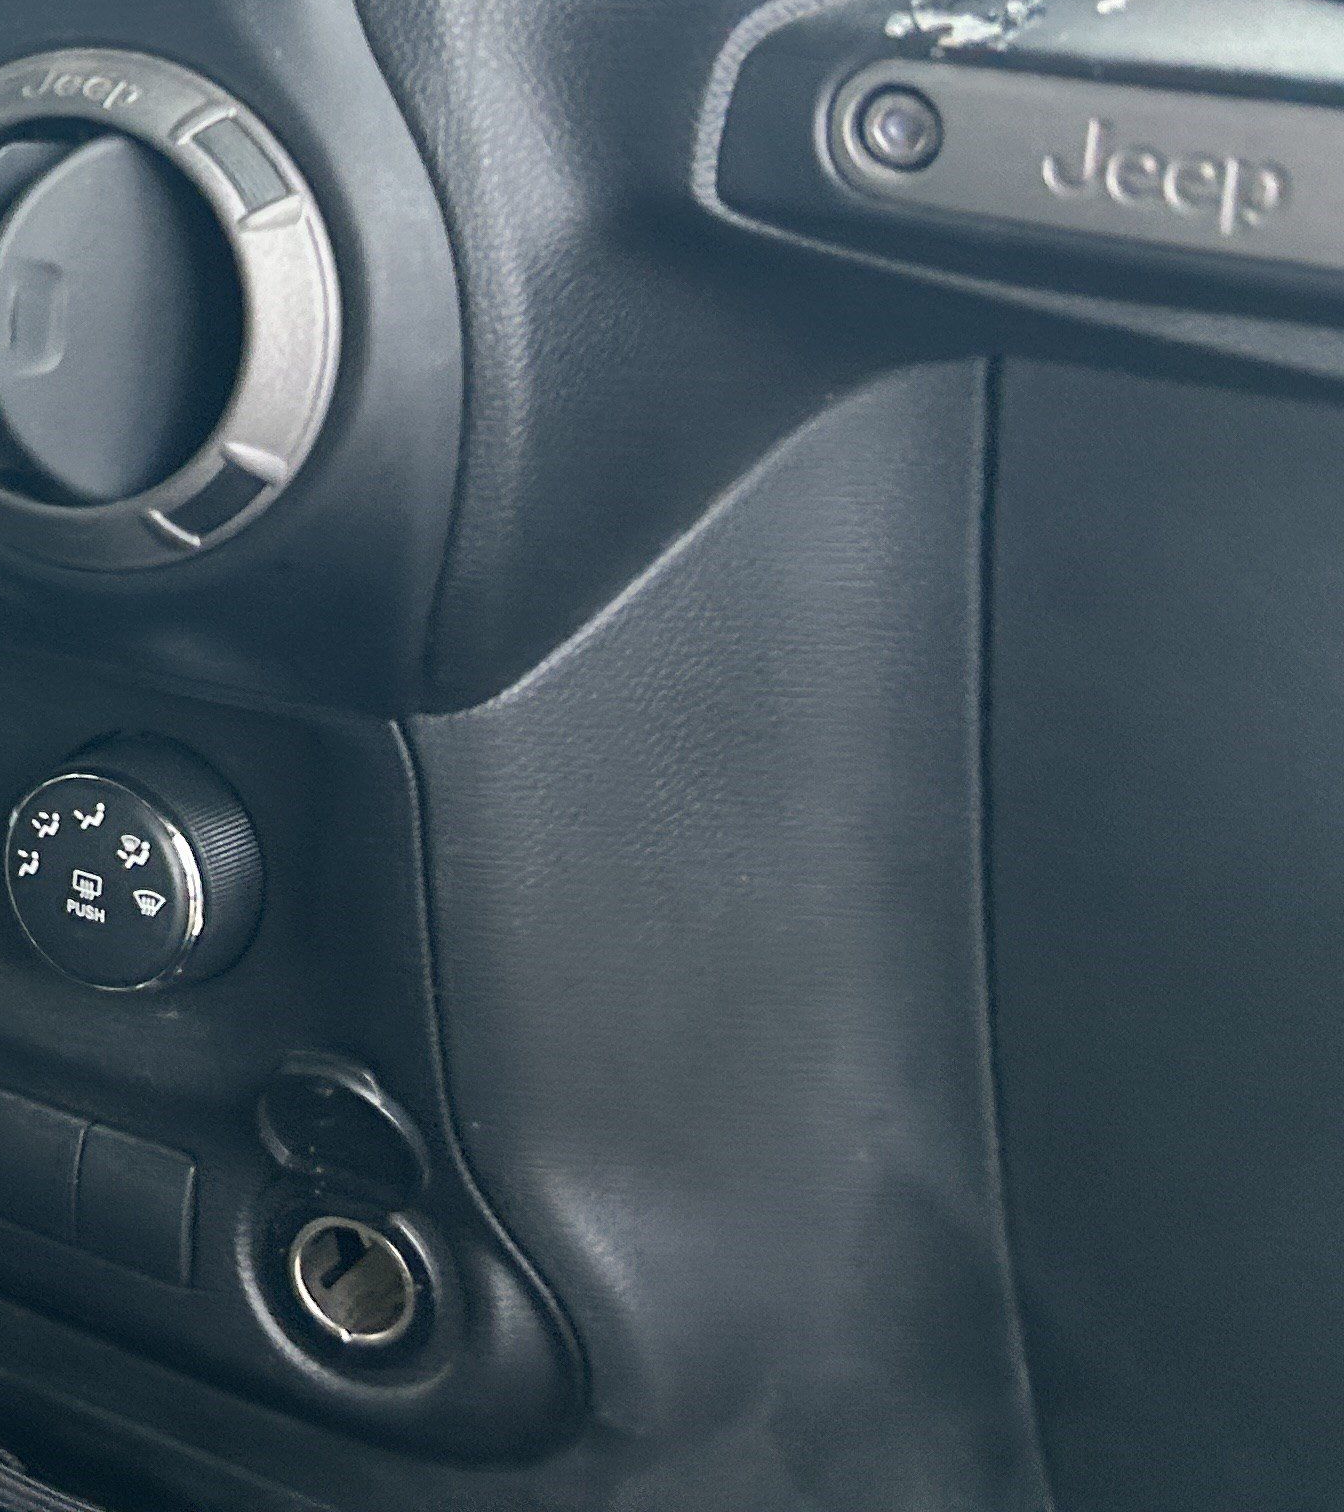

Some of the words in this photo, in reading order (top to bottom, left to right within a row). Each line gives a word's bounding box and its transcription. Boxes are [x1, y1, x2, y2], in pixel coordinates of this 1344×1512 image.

[21, 68, 142, 110] Jeep
[1041, 116, 1288, 236] Jeep
[66, 899, 106, 923] PUSH
